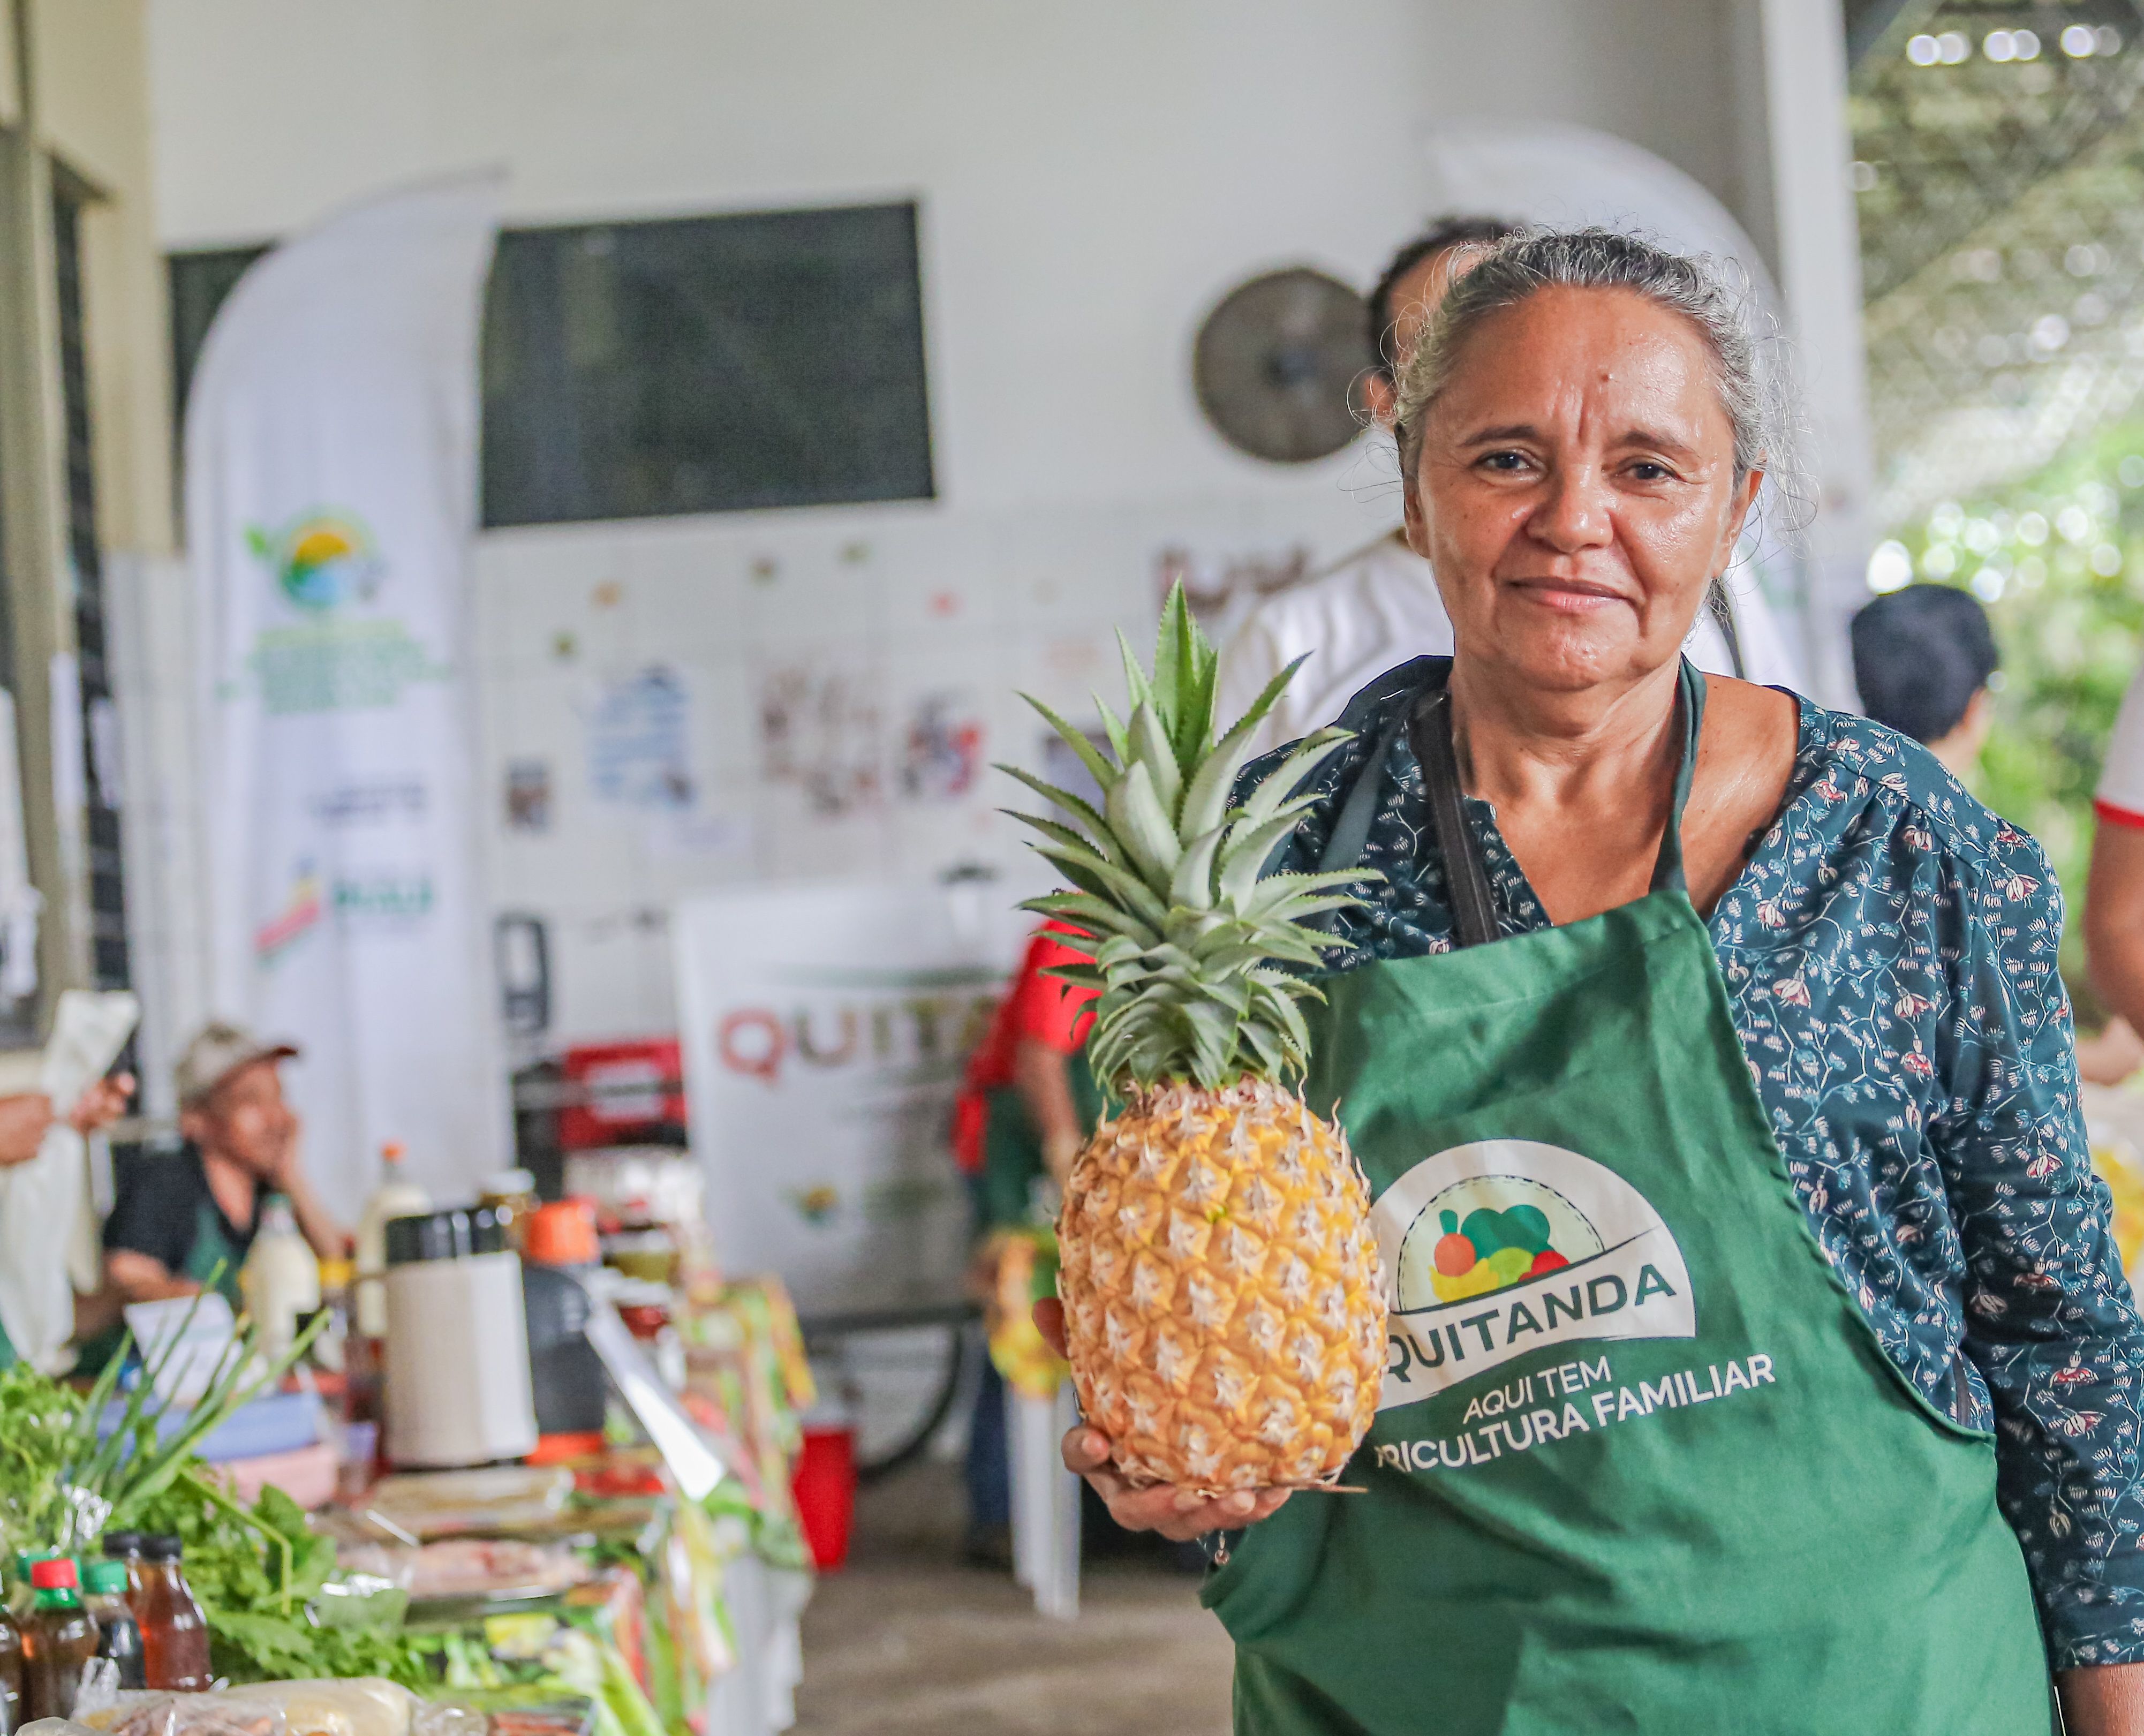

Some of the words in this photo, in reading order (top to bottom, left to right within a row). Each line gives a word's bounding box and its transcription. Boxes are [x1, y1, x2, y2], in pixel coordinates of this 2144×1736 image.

[1374, 1402, 1590, 1473] RICULTURA
[1591, 1353, 1776, 1427] FAMILIAR
[1462, 1376, 1534, 1424] AQUI
[1537, 1355, 1612, 1398] TEM
